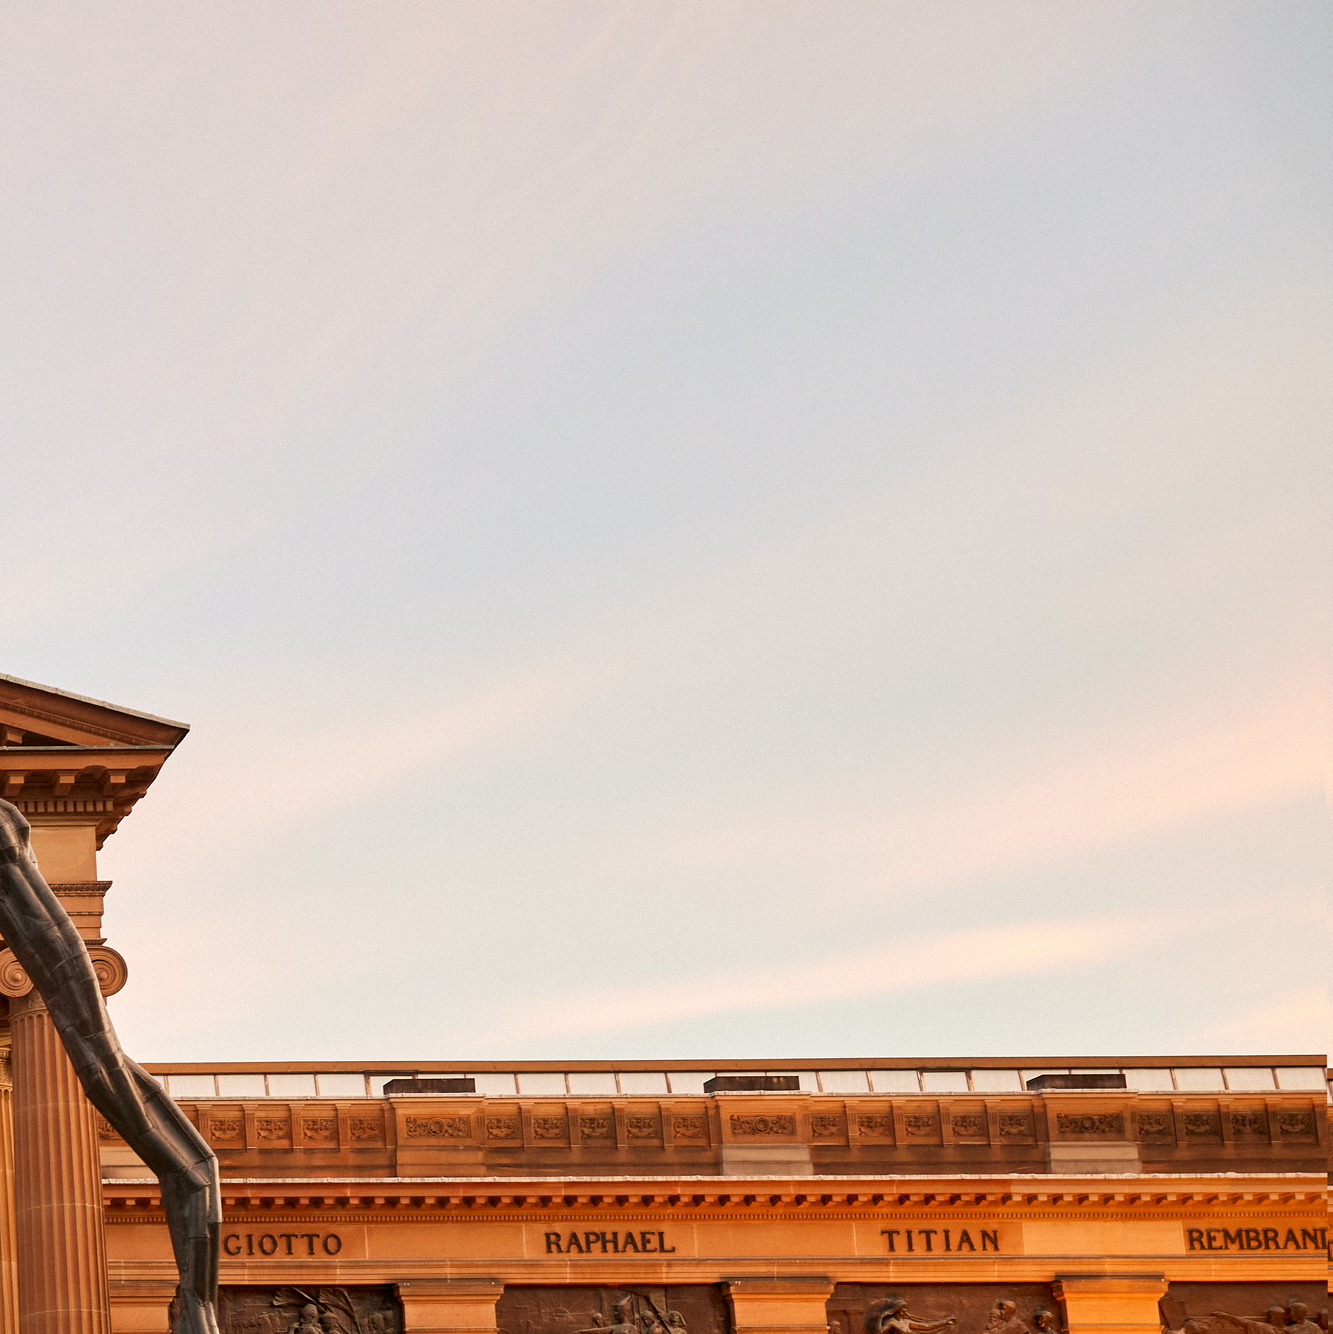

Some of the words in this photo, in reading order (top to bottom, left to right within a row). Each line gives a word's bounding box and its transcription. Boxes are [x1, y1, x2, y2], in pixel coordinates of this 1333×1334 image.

[223, 1233, 342, 1256] GIOTTO
[544, 1230, 676, 1255] RAPHAEL
[880, 1228, 1000, 1253] TITIAN
